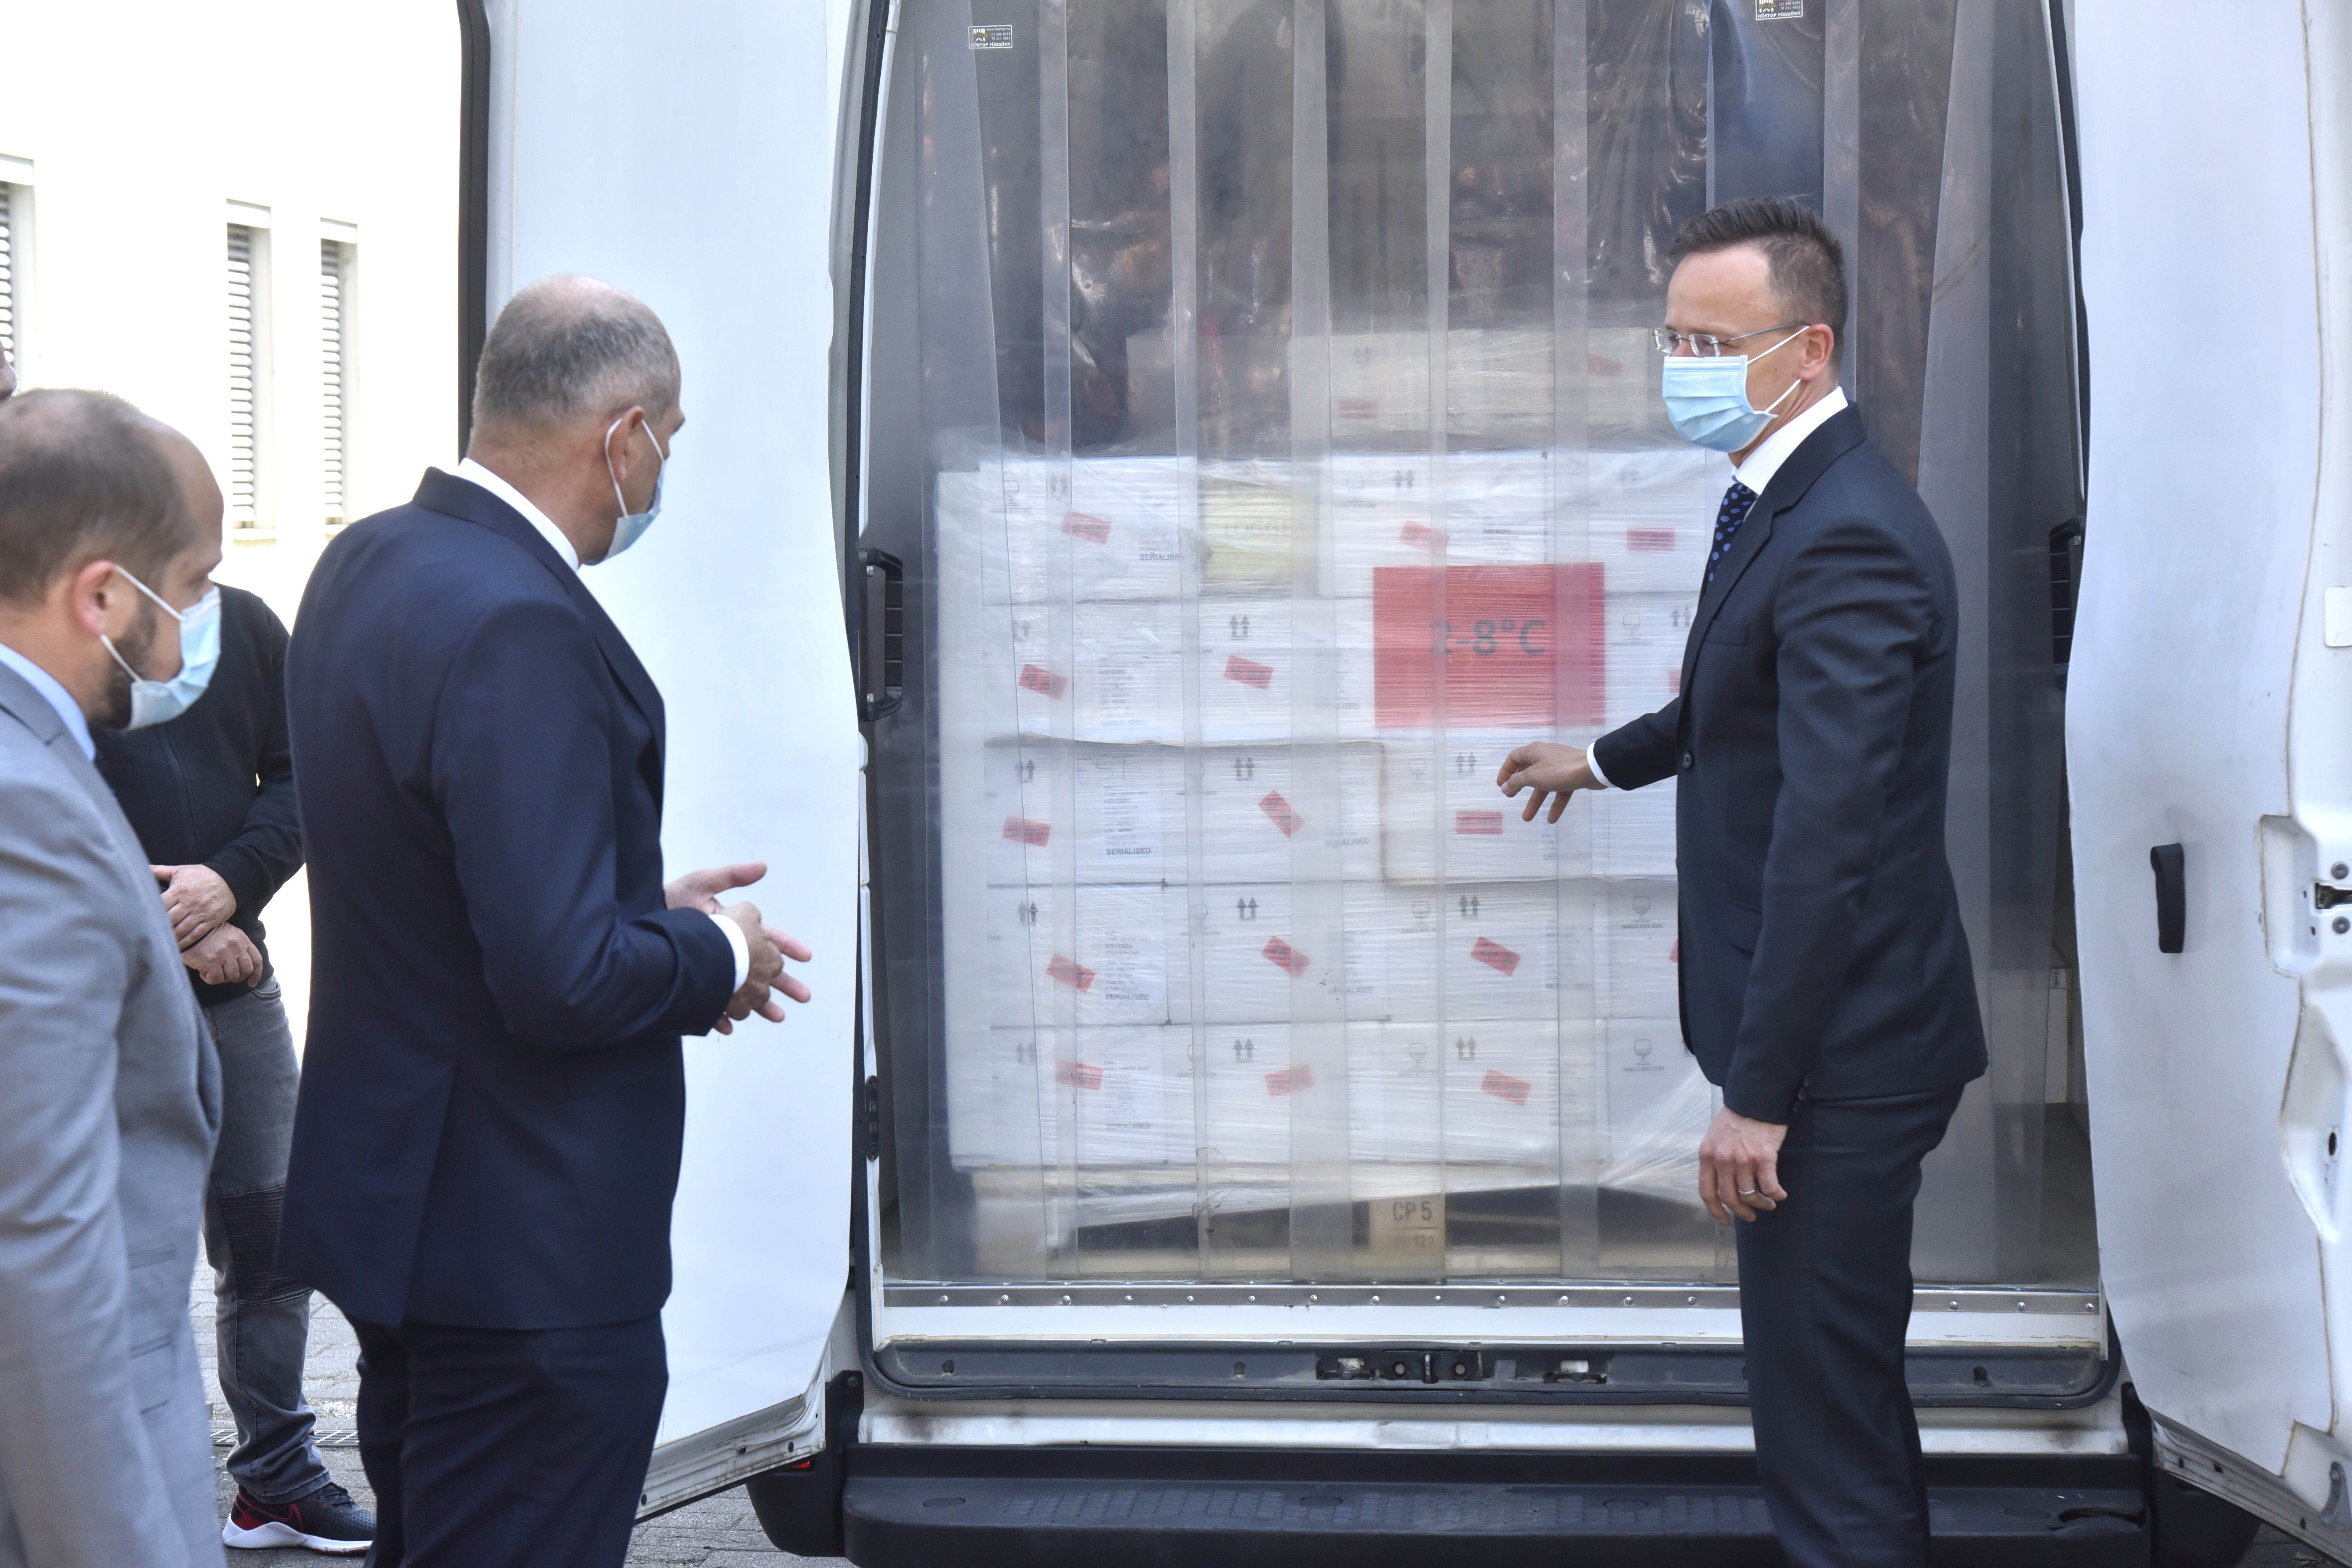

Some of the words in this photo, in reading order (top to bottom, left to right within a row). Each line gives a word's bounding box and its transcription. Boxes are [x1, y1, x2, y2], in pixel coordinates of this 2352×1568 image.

[1324, 837, 1369, 847] ALISED
[1106, 847, 1152, 856] SERIALISED
[1393, 1201, 1416, 1221] CP
[1421, 1200, 1433, 1221] 5
